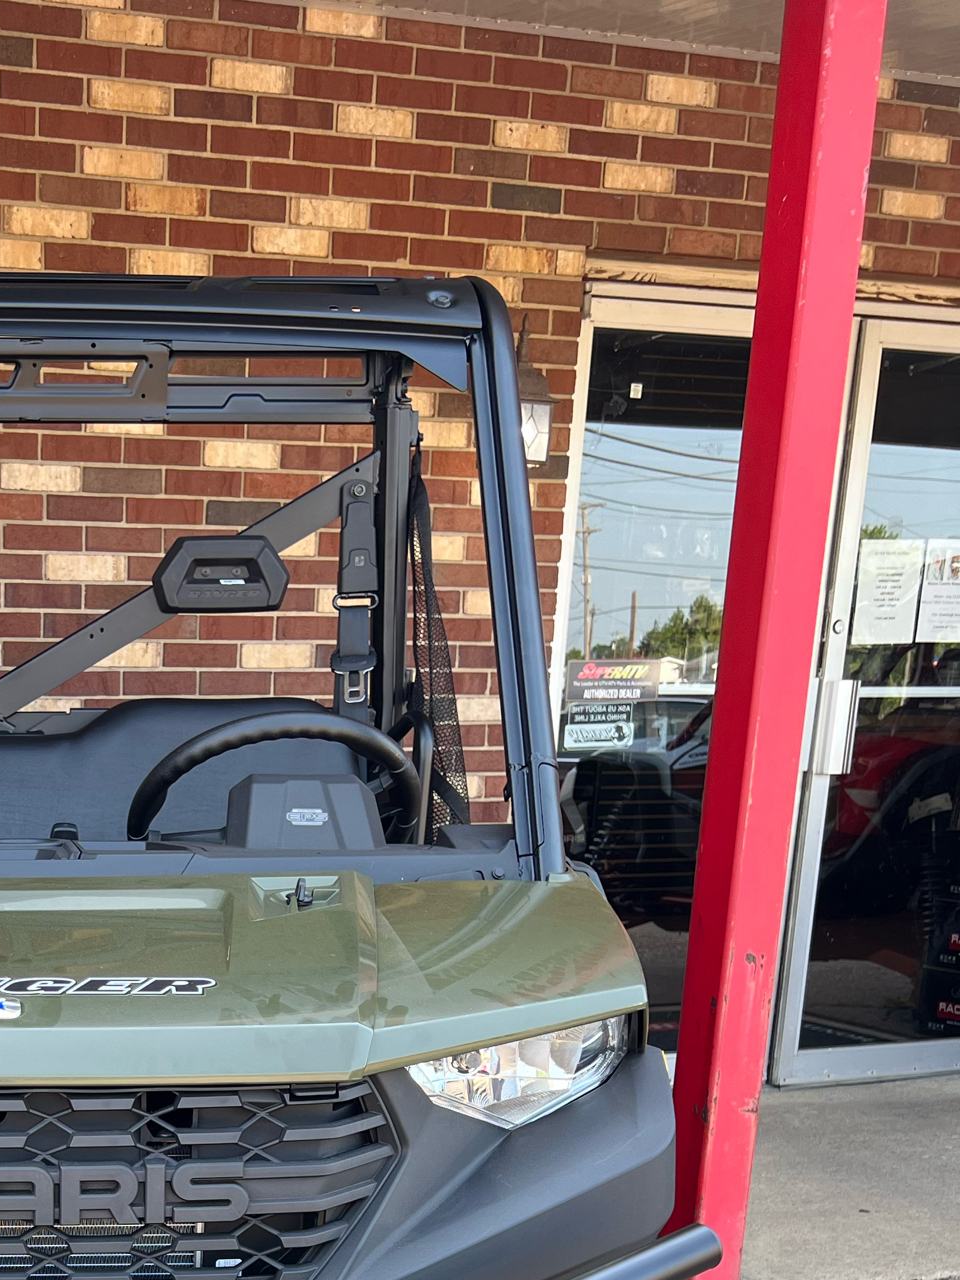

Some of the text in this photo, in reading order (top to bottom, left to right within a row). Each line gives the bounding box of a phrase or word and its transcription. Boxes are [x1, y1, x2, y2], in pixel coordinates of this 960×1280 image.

[187, 590, 261, 599] RANGER
[583, 688, 641, 699] AUTHORIZED DEALER
[285, 812, 329, 822] EPS
